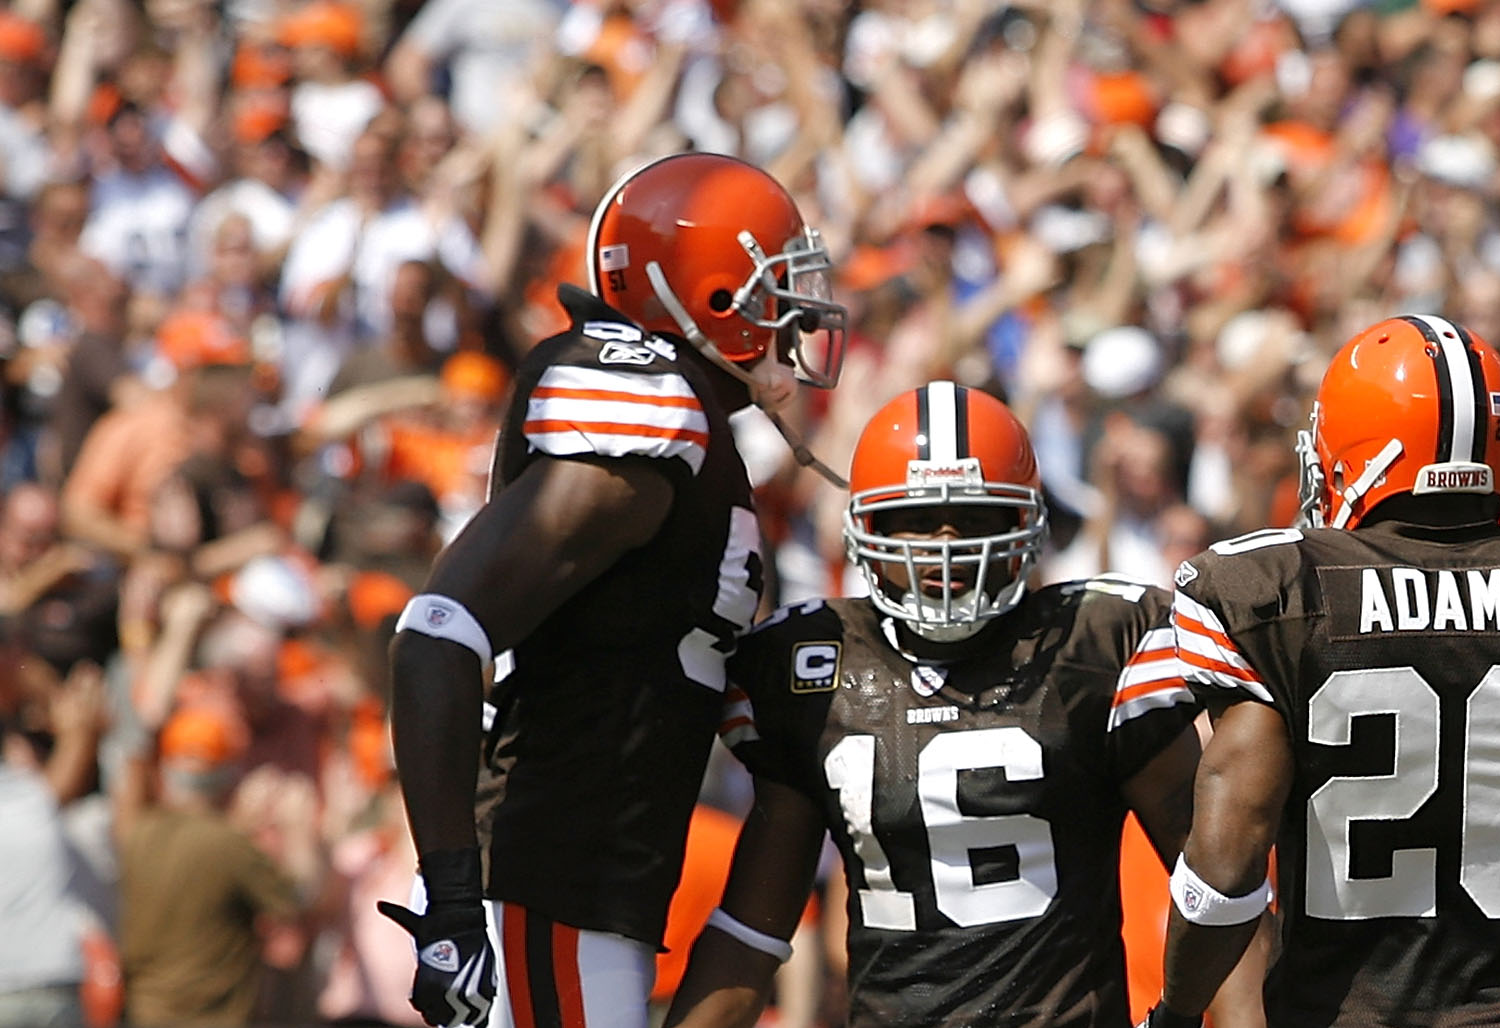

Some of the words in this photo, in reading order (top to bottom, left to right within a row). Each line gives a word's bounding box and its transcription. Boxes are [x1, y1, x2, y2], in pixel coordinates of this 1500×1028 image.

[1427, 470, 1489, 488] BROWNS
[795, 645, 837, 680] C
[906, 704, 960, 724] BROWNS
[823, 726, 1059, 931] 16
